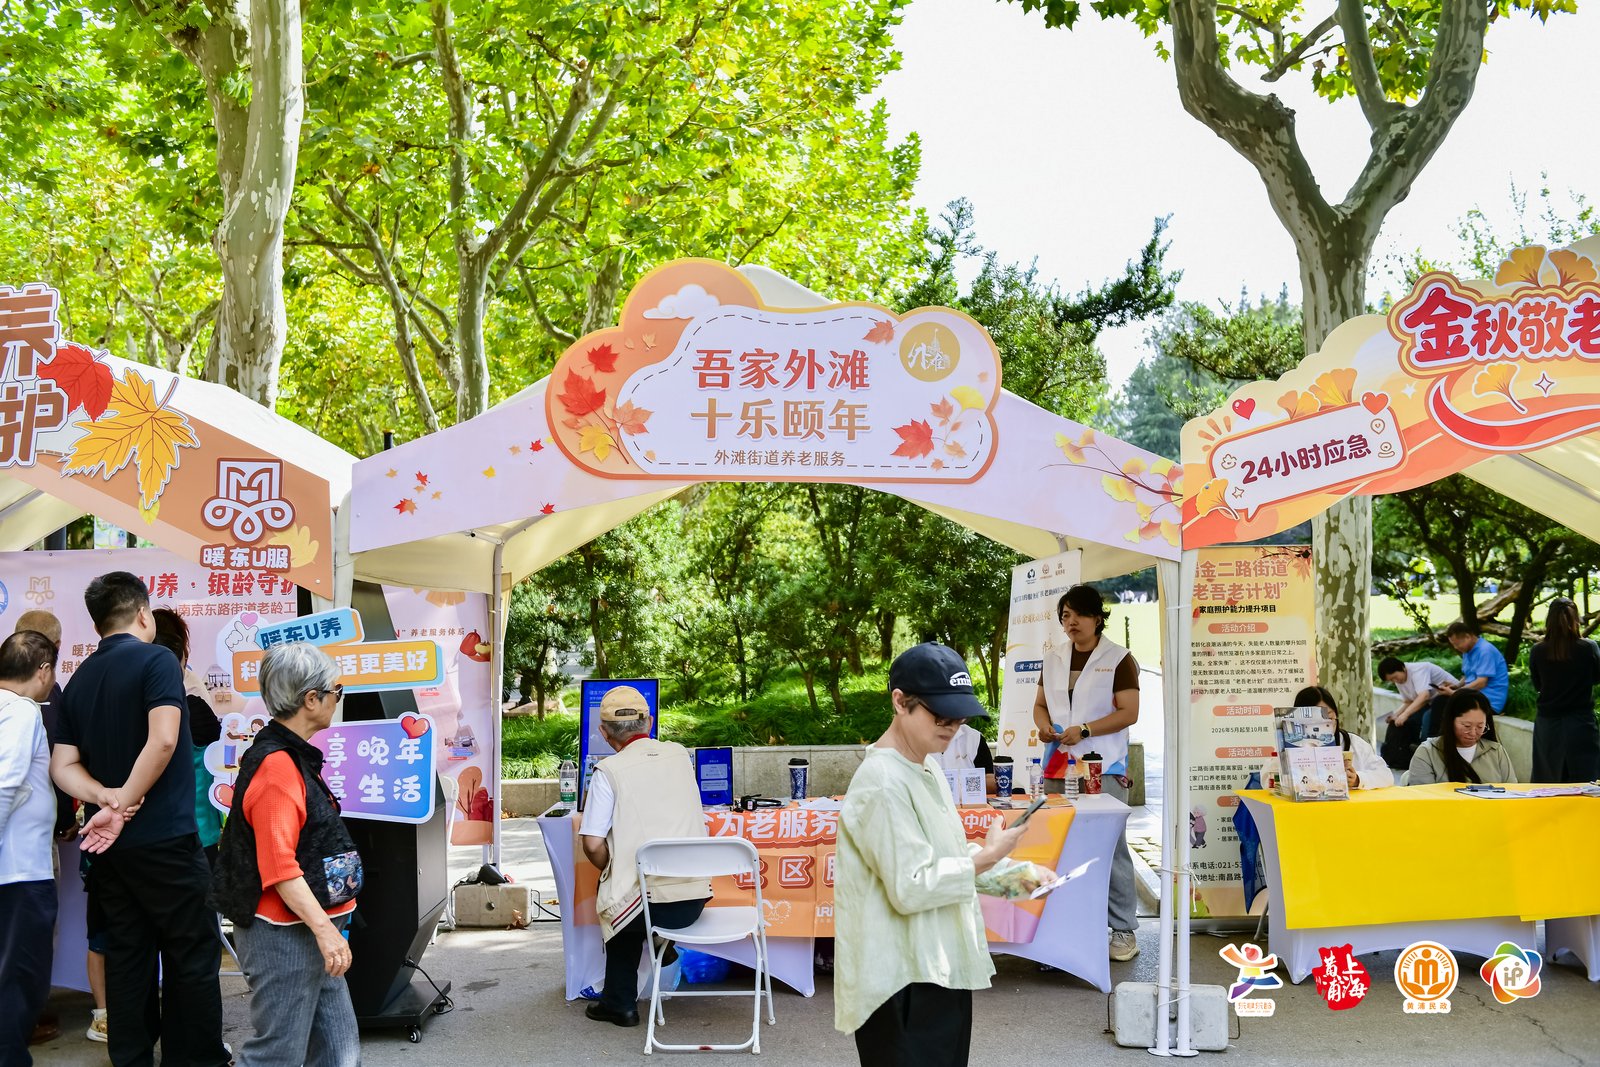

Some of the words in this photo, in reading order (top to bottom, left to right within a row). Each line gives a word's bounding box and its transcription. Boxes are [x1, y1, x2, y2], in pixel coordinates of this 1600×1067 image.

[693, 349, 870, 390] 吾家外滩
[691, 399, 871, 441] 十乐颐年
[714, 448, 847, 467] 外滩街道养老服务
[1240, 433, 1372, 485] 24小时应急
[203, 547, 290, 569] 暖东U服
[1195, 560, 1289, 578] 金二路街道
[1199, 605, 1276, 614] 家庭照护能力提升项目
[260, 617, 342, 650] 暖东U养
[1221, 624, 1256, 633] 活动介绍
[1226, 706, 1261, 715] 活动时间
[1228, 748, 1263, 757] 活动地点
[1190, 861, 1242, 870] 系电话:021-5
[1190, 873, 1241, 882] 地址:南昌路
